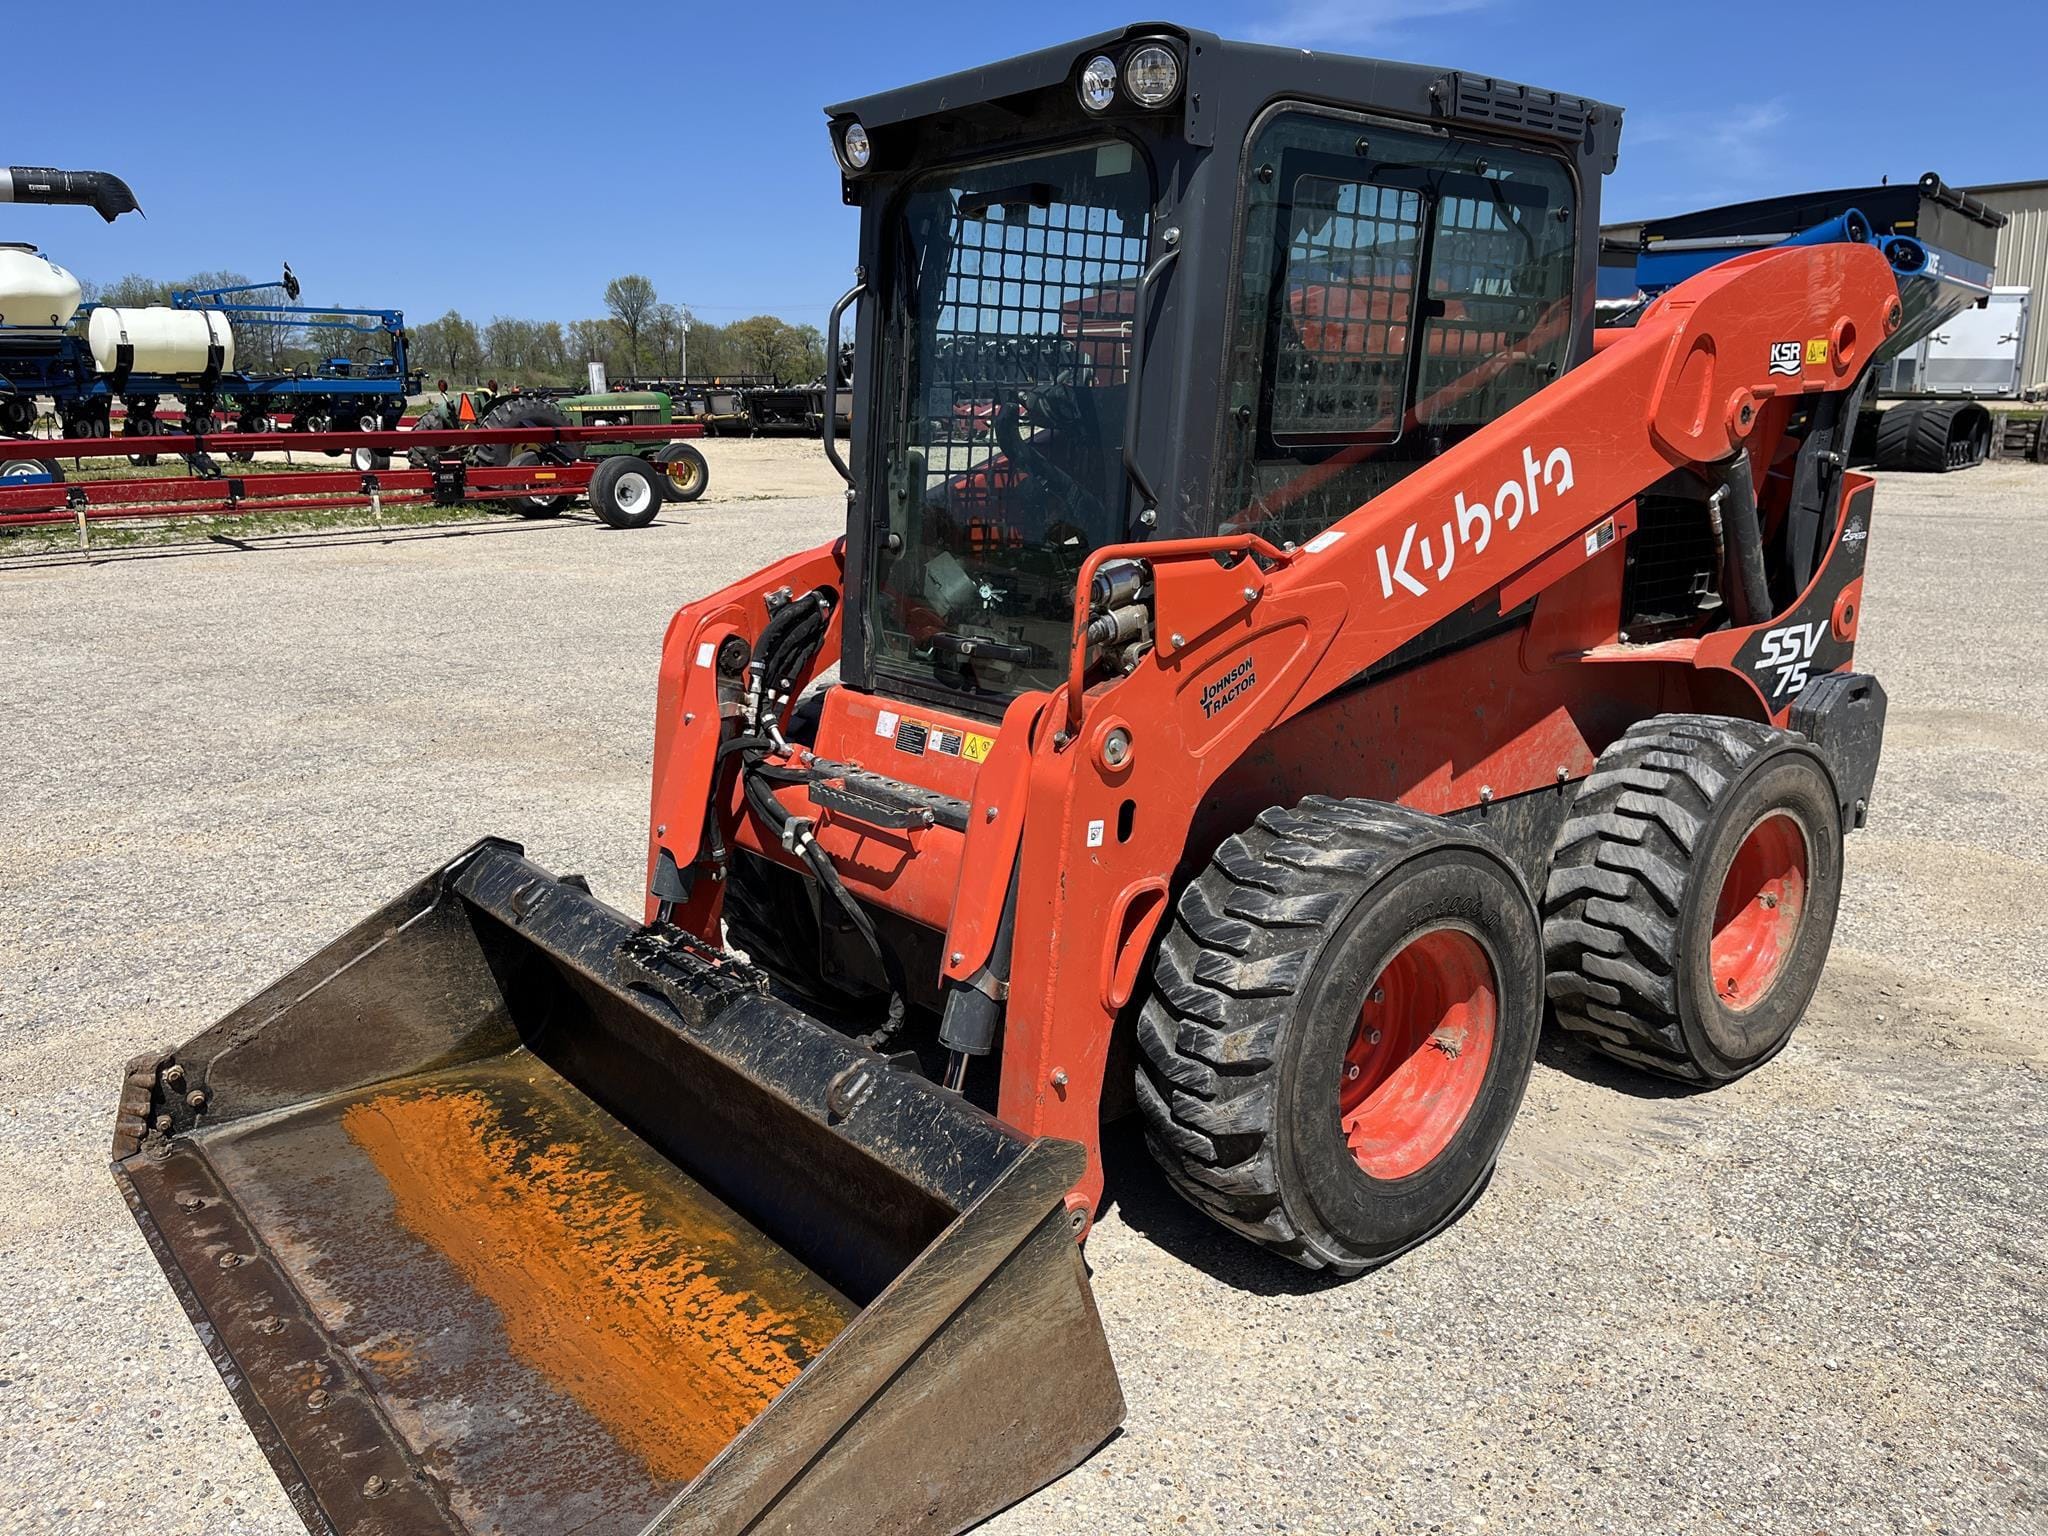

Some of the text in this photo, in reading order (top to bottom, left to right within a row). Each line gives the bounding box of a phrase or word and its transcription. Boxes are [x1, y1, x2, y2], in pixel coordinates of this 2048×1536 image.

[1770, 342, 1801, 361] KSR
[1376, 445, 1574, 599] Kubota
[1754, 619, 1829, 669] SSV
[1199, 657, 1253, 706] JOHNSON
[1203, 673, 1256, 719] TRACTOR
[1772, 660, 1811, 698] 75
